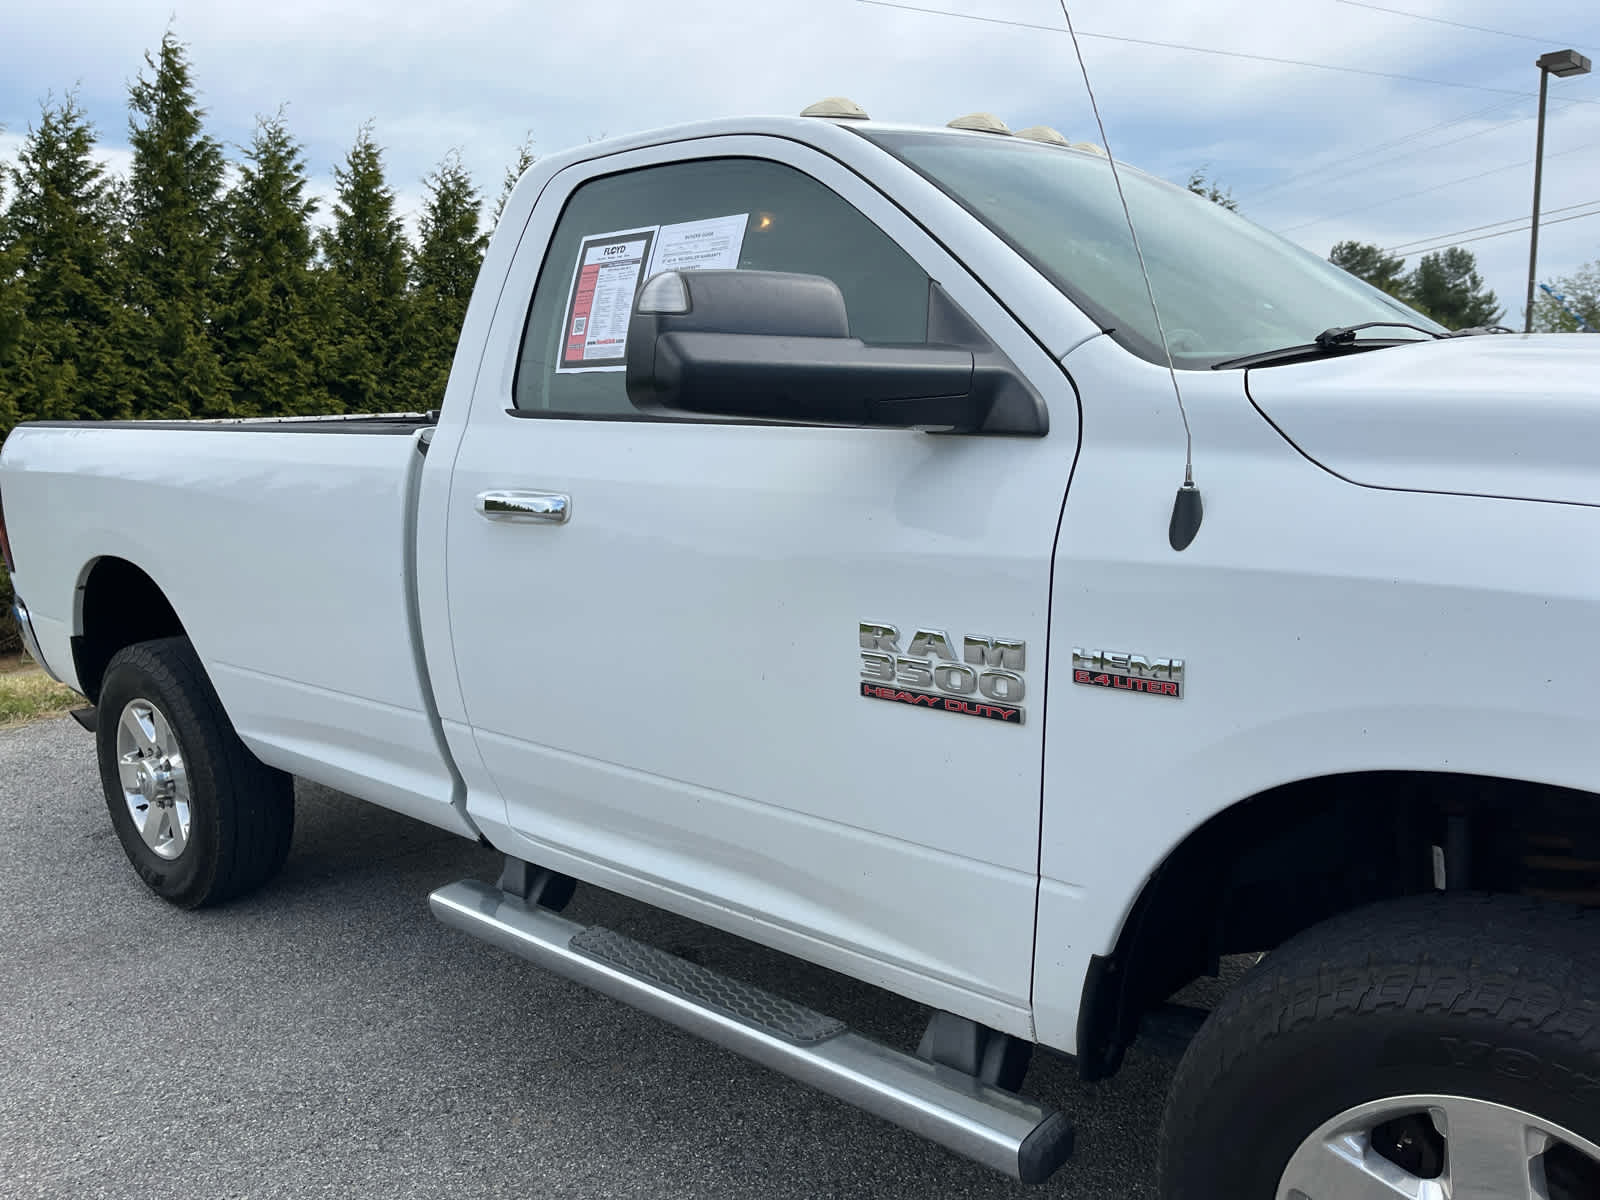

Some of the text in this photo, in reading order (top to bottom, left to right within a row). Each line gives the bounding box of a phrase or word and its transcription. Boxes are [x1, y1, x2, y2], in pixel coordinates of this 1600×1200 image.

[603, 245, 626, 256] FLOYD
[859, 621, 1026, 672] RAM
[1072, 646, 1186, 682] HEMI
[860, 651, 1026, 703] 3500
[1074, 669, 1177, 696] 6.4 LITER
[862, 683, 1017, 721] HEAVY DUTY
